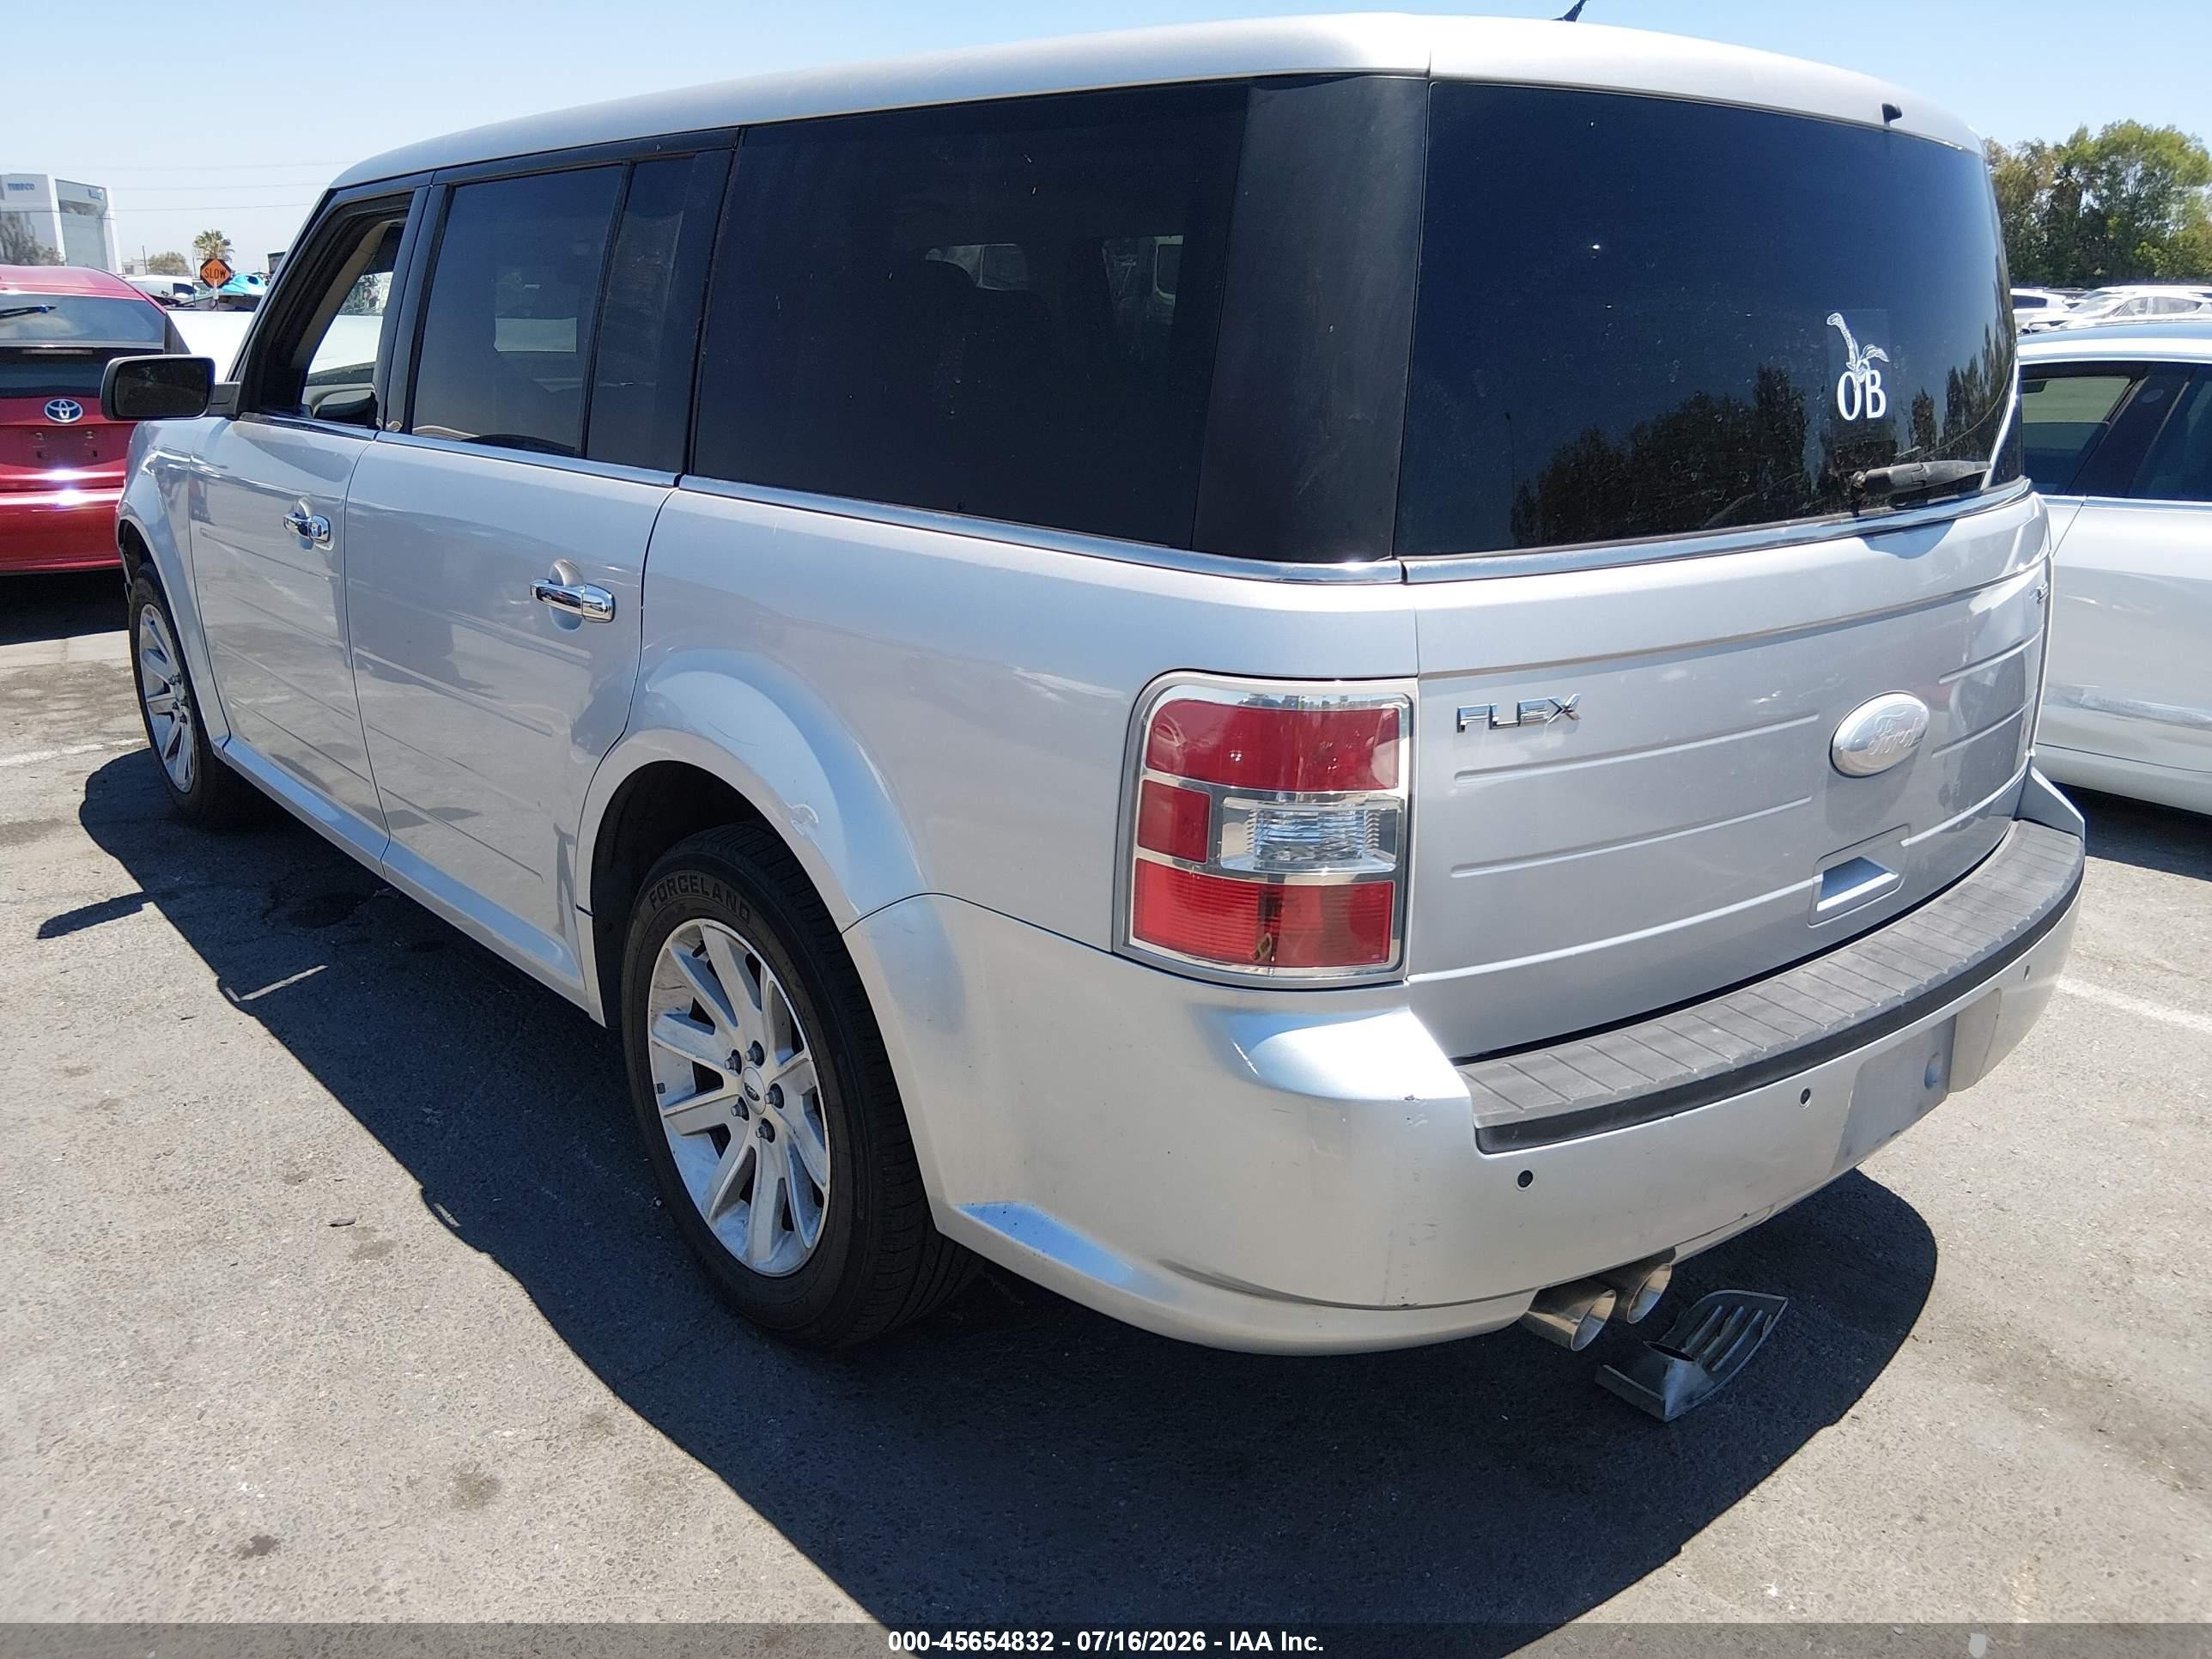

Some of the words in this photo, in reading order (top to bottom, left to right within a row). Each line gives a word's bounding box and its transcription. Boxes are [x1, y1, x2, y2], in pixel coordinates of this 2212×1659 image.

[204, 267, 227, 279] SLOW
[1837, 369, 1887, 422] OB
[1456, 693, 1582, 733] FLEX
[1868, 711, 1924, 756] Ford
[649, 874, 750, 925] FORCELAND
